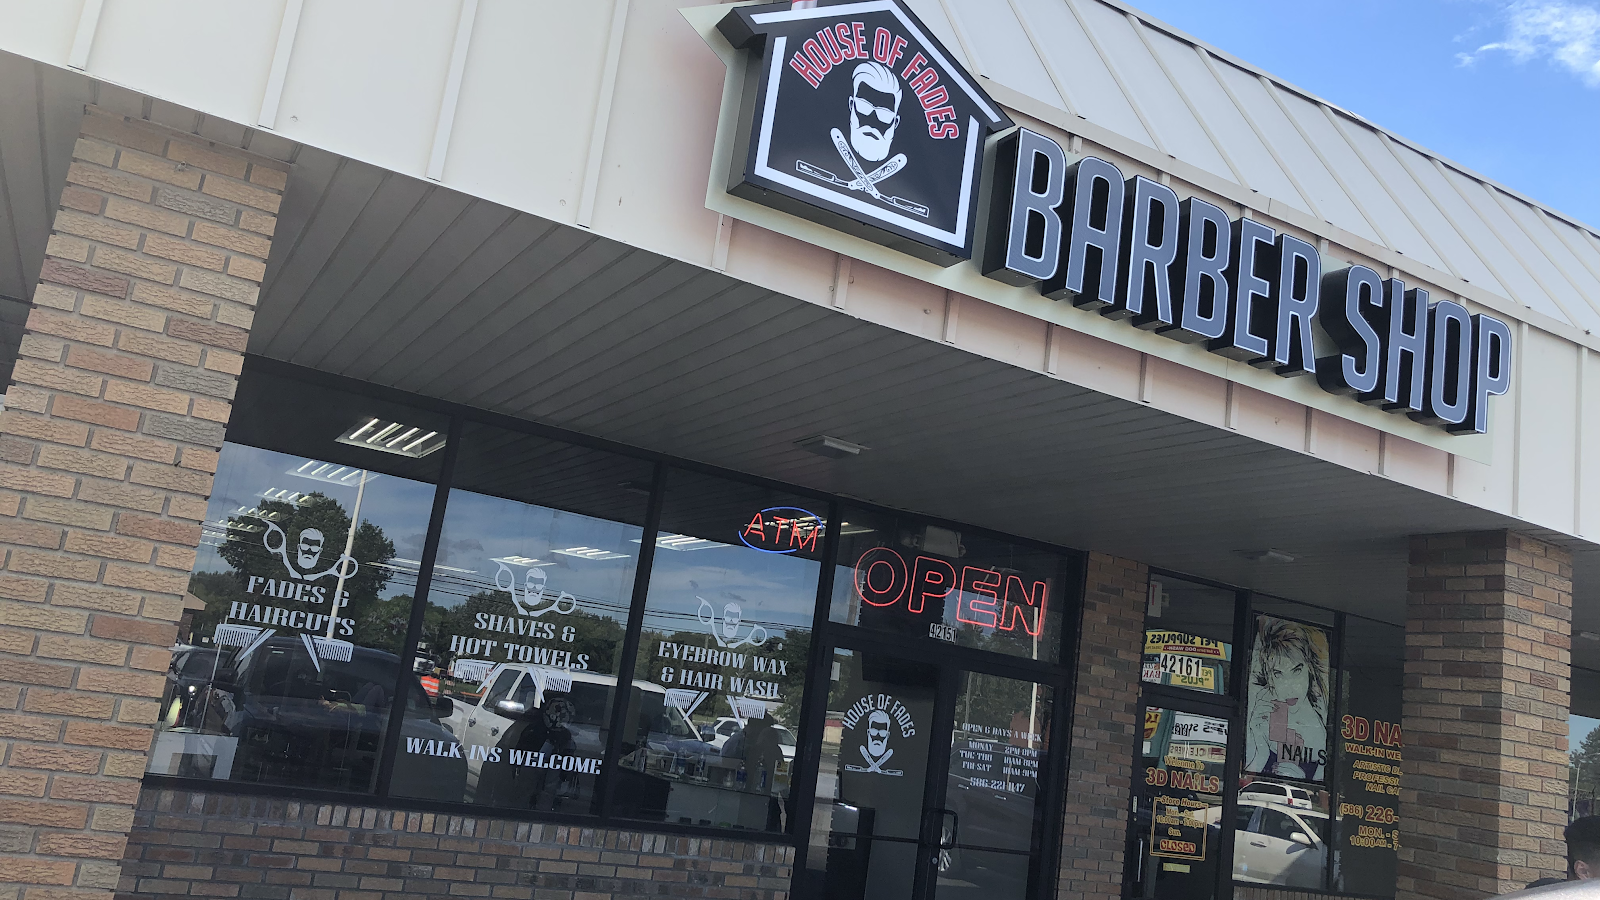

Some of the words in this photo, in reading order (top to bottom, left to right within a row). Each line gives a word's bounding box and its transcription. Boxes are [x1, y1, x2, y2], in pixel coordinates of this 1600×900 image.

[789, 22, 869, 89] HOUSE
[873, 27, 907, 67] OF
[901, 52, 959, 139] FADES
[1005, 127, 1321, 374] BARBER
[1342, 264, 1512, 434] SHOP
[744, 513, 818, 551] ATM
[246, 575, 326, 604] FADES
[854, 547, 1046, 636] OPEN
[229, 601, 356, 638] HAIRCUTS
[474, 612, 556, 640] SHAVES
[562, 626, 576, 642] &
[930, 623, 956, 642] 42151
[450, 635, 497, 657] HOT
[504, 642, 590, 670] TOWELS
[658, 641, 747, 669] EYEBROW
[753, 656, 788, 676] WAX
[1161, 654, 1200, 677] 42161
[661, 666, 674, 683] &
[679, 669, 723, 690] HAIR
[730, 676, 779, 697] WASH
[842, 694, 875, 730] HOUSE
[877, 694, 892, 710] OF
[890, 700, 915, 738] FADES
[1341, 715, 1369, 741] 3D
[962, 723, 983, 734] OPEN
[992, 727, 1012, 737] DAYS
[1014, 731, 1018, 739] A
[1021, 731, 1041, 742] WEEK
[406, 737, 462, 759] WALK
[469, 745, 502, 762] INS
[509, 749, 602, 775] WELCOME
[1164, 755, 1195, 769] Welcome
[1282, 744, 1327, 766] NAILS
[1345, 743, 1386, 758] WALK-IN
[1353, 760, 1391, 773] ARTISTIC
[1353, 771, 1399, 785] PROFESSI
[1145, 767, 1168, 787] 3D
[1170, 771, 1220, 793] NAILS
[1365, 783, 1385, 794] NAIL
[1161, 795, 1180, 806] Store
[1181, 798, 1201, 808] Hours
[1339, 803, 1363, 818] (586)
[1350, 835, 1386, 848] 10:00AM
[1358, 825, 1384, 838] MON.
